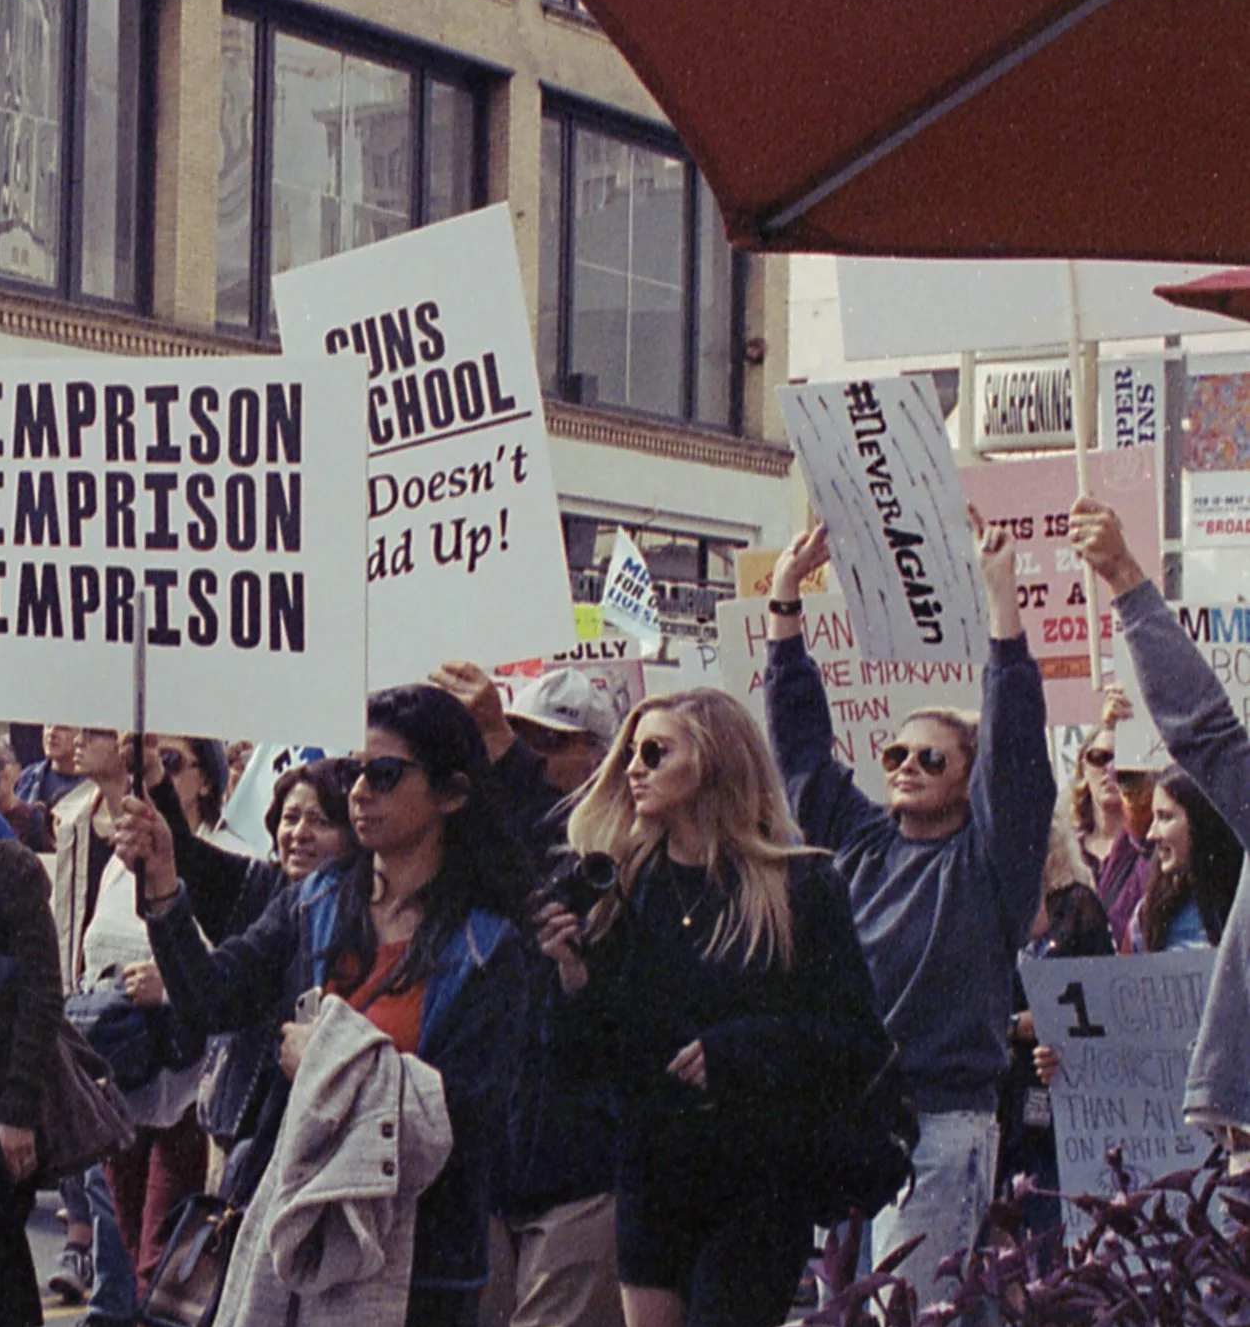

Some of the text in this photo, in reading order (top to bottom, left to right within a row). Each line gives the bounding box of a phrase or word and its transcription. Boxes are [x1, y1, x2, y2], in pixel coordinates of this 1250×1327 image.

[367, 352, 516, 447] CHOOL
[984, 369, 1073, 435] SHARPENING
[367, 444, 528, 520] Doesn't
[366, 507, 508, 584] dd Up!
[1044, 514, 1069, 537] IS
[614, 574, 644, 600] FOR
[1017, 582, 1086, 609] OT A
[745, 609, 854, 658] HAN
[832, 696, 891, 722] THAN
[1057, 973, 1205, 1038] 1 CHI
[1062, 1093, 1129, 1131] THAN
[1064, 1137, 1097, 1163] ON
